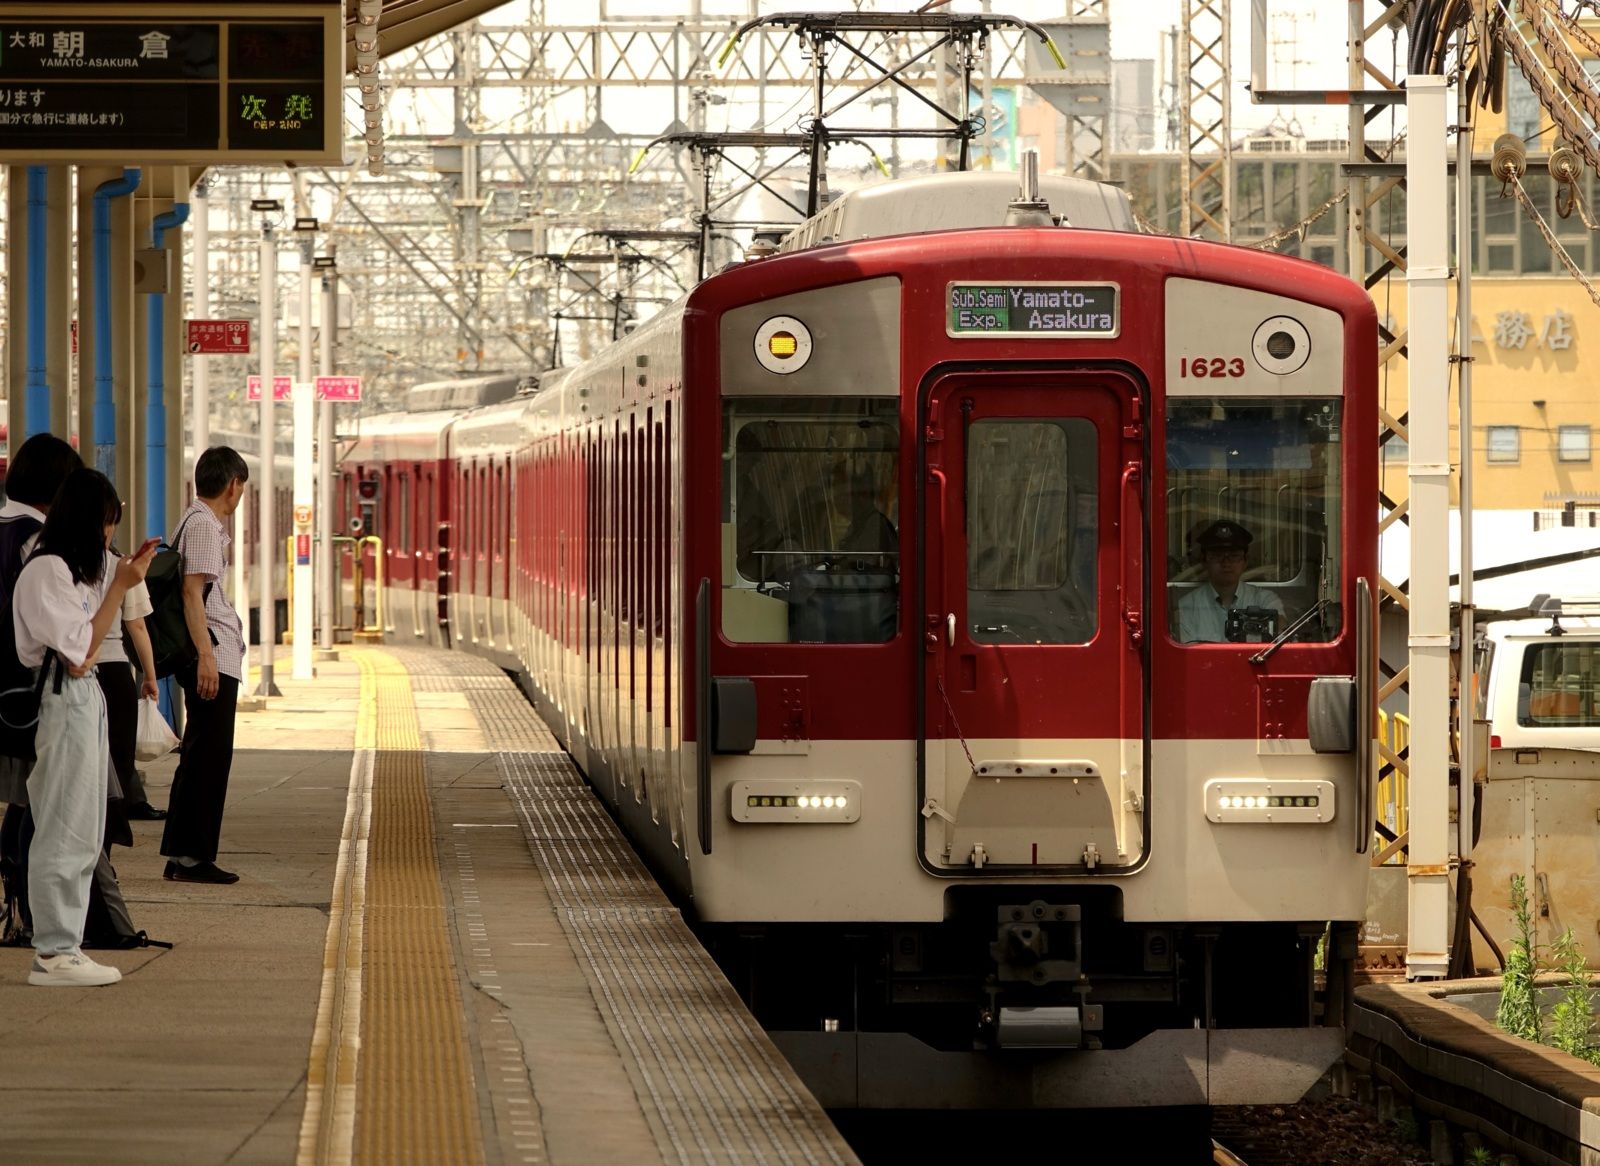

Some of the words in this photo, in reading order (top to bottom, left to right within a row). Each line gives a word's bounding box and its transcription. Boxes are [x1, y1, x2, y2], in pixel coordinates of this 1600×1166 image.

[39, 58, 139, 68] YAMATO-ASAKURA
[1009, 288, 1094, 308] Yamato-
[228, 324, 246, 332] SOS
[959, 310, 1002, 330] Exp.
[1028, 309, 1112, 329] Asakura
[1180, 357, 1246, 378] 1623
